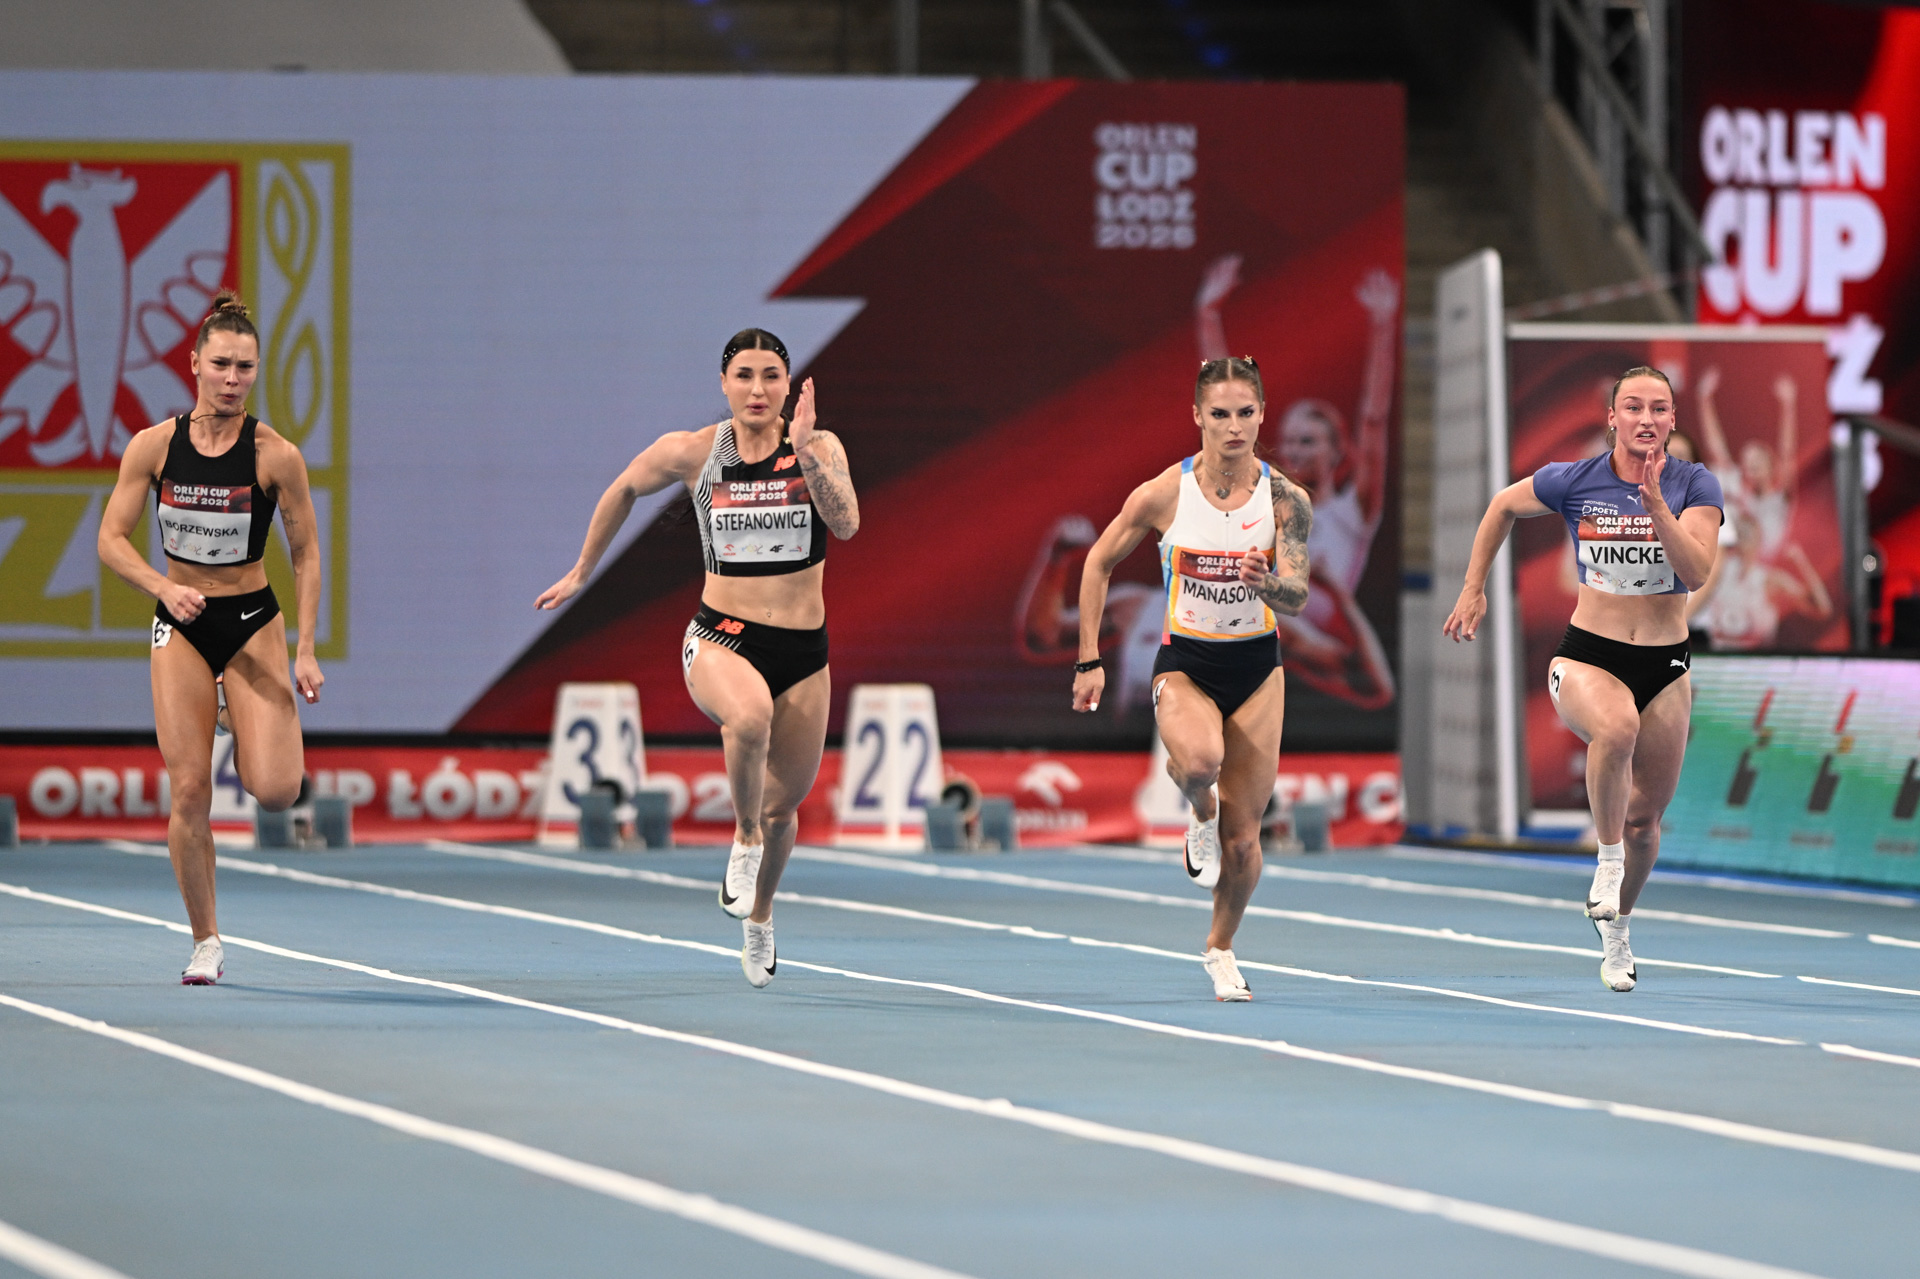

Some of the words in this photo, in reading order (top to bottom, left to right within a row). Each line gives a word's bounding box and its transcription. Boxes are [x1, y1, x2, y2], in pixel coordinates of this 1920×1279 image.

[1095, 124, 1196, 149] ORLEN
[1701, 107, 1886, 188] ORLEN
[1096, 151, 1196, 189] CUP
[1096, 224, 1195, 249] 2026
[1702, 189, 1886, 316] CUP
[173, 485, 208, 496] ORLEN
[210, 488, 230, 497] CUP
[730, 483, 765, 492] ORLEN
[767, 481, 787, 490] CUP
[759, 492, 788, 500] 2026
[201, 498, 230, 506] 2026
[1592, 506, 1618, 515] POETS
[165, 519, 239, 538] BORZEWSKA
[715, 510, 807, 531] STEFANOWICZ
[1596, 516, 1632, 526] ORLEN
[1633, 517, 1653, 526] CUP
[1624, 527, 1654, 535] 2026
[1197, 556, 1234, 567] ORLEN
[1590, 546, 1664, 565] VINCKE
[854, 720, 885, 808] 2
[903, 720, 929, 808] 2
